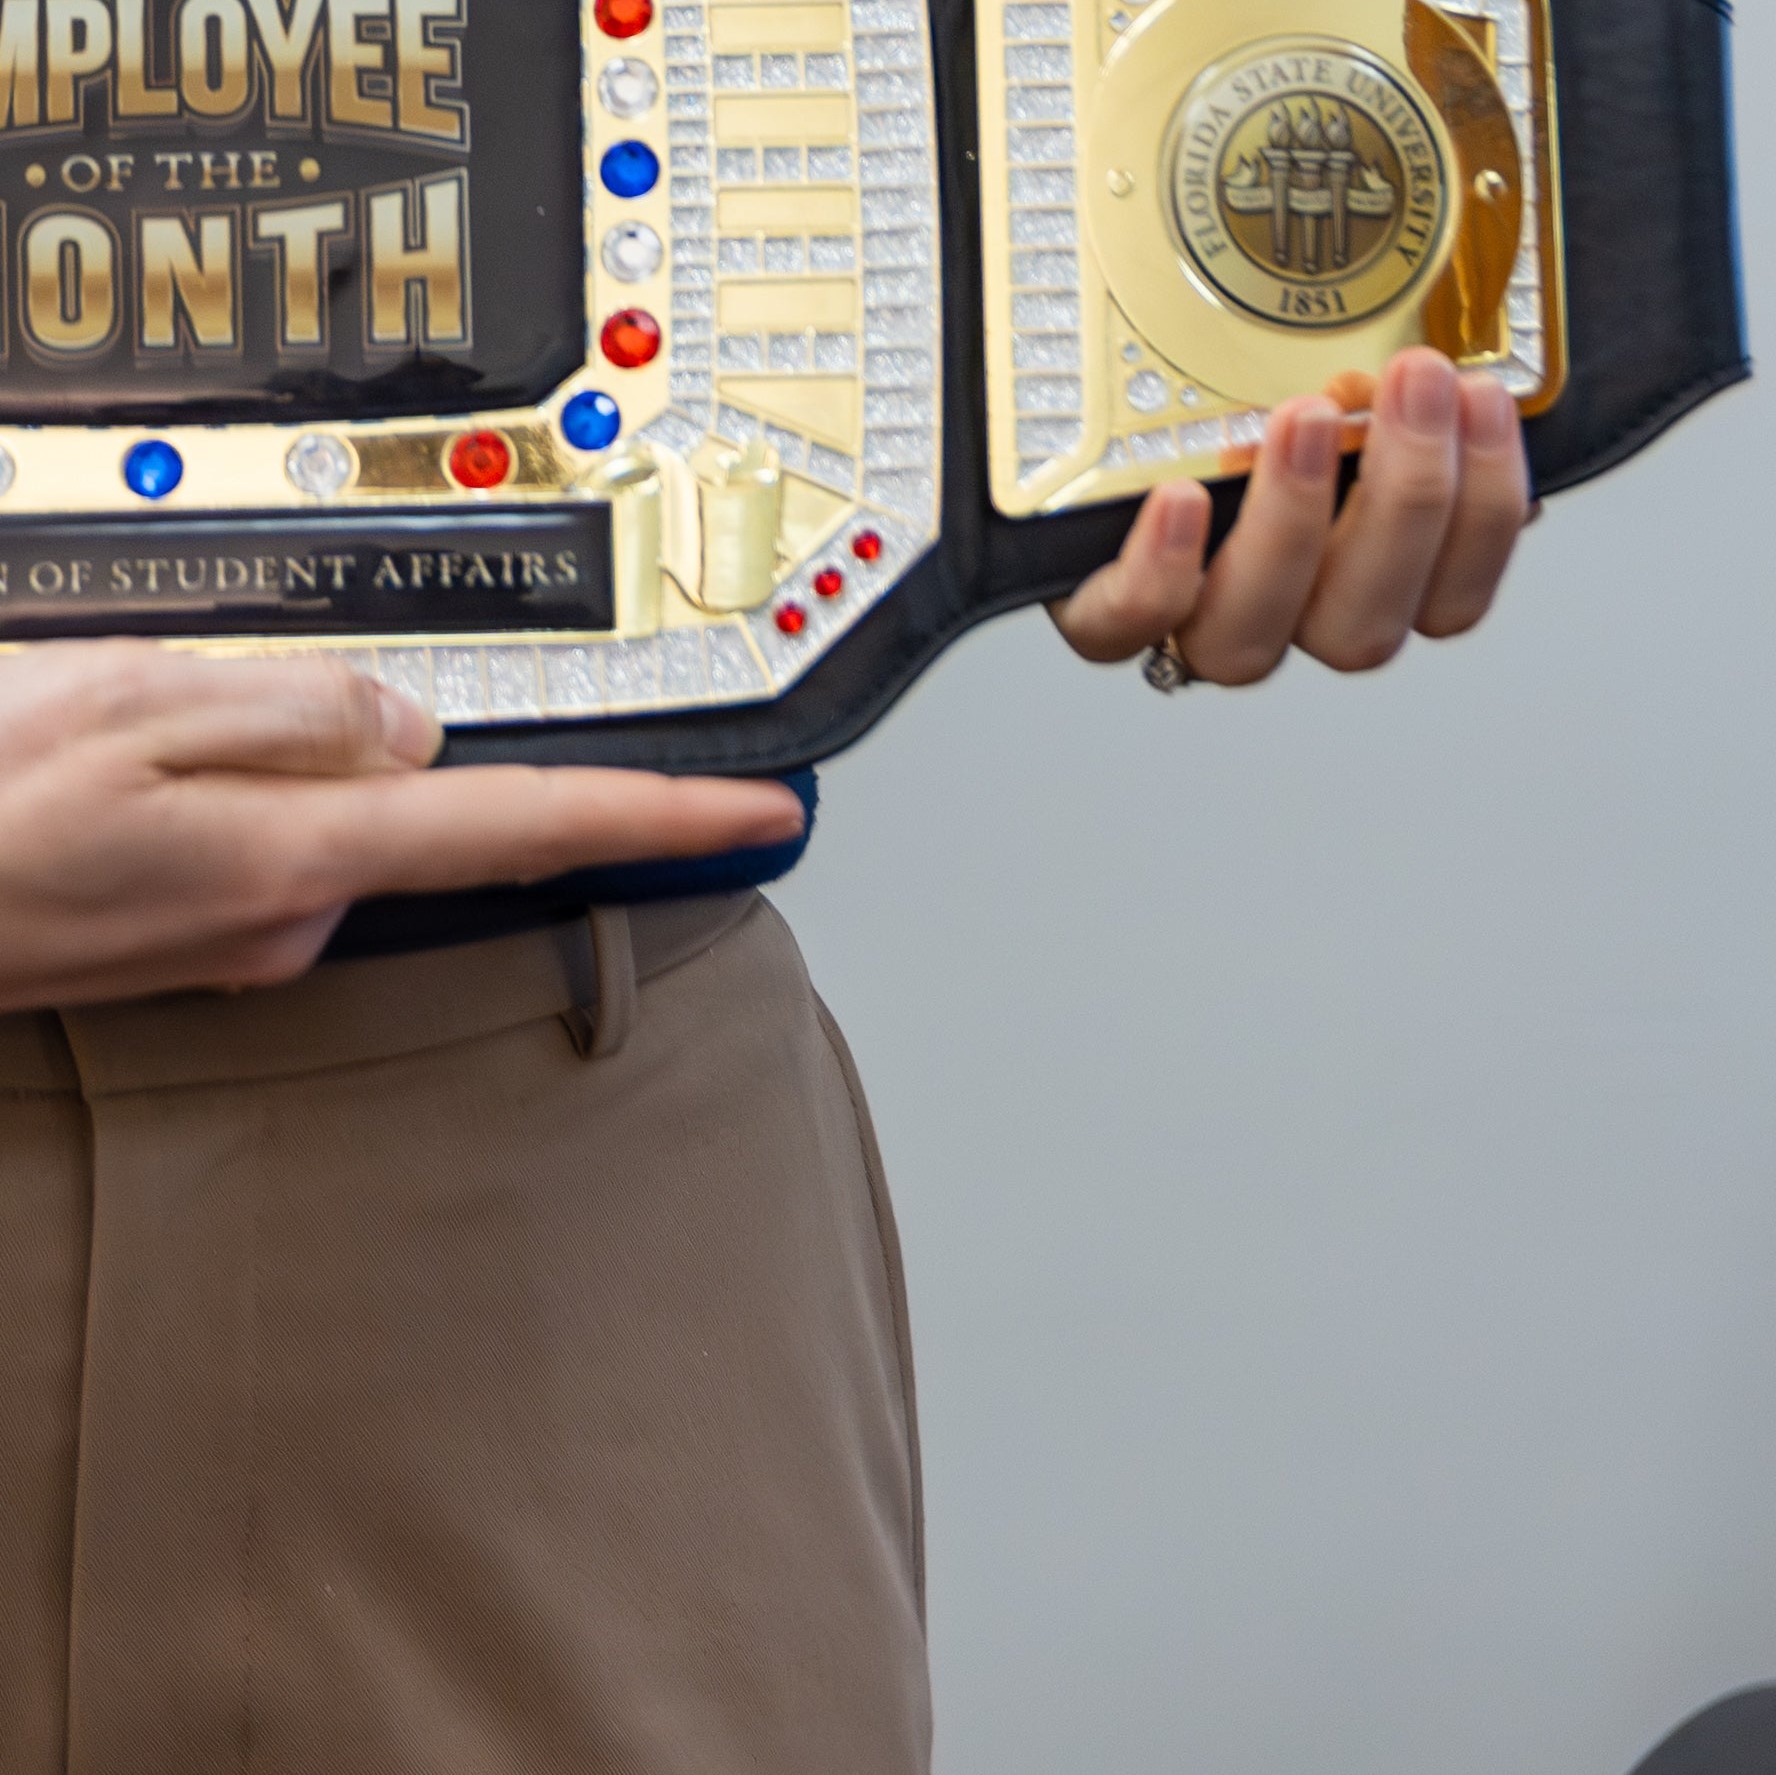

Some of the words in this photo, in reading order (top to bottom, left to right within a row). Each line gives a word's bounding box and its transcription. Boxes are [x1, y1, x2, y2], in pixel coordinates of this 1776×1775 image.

[61, 153, 135, 194] OF
[155, 151, 282, 191] THE
[1184, 105, 1231, 260] FLORIDA
[1232, 58, 1334, 98] STATE
[1348, 69, 1434, 266] UNIVERSITY
[29, 559, 94, 595] OF
[110, 555, 357, 593] STUDENT
[373, 550, 580, 589] AFFAIRS
